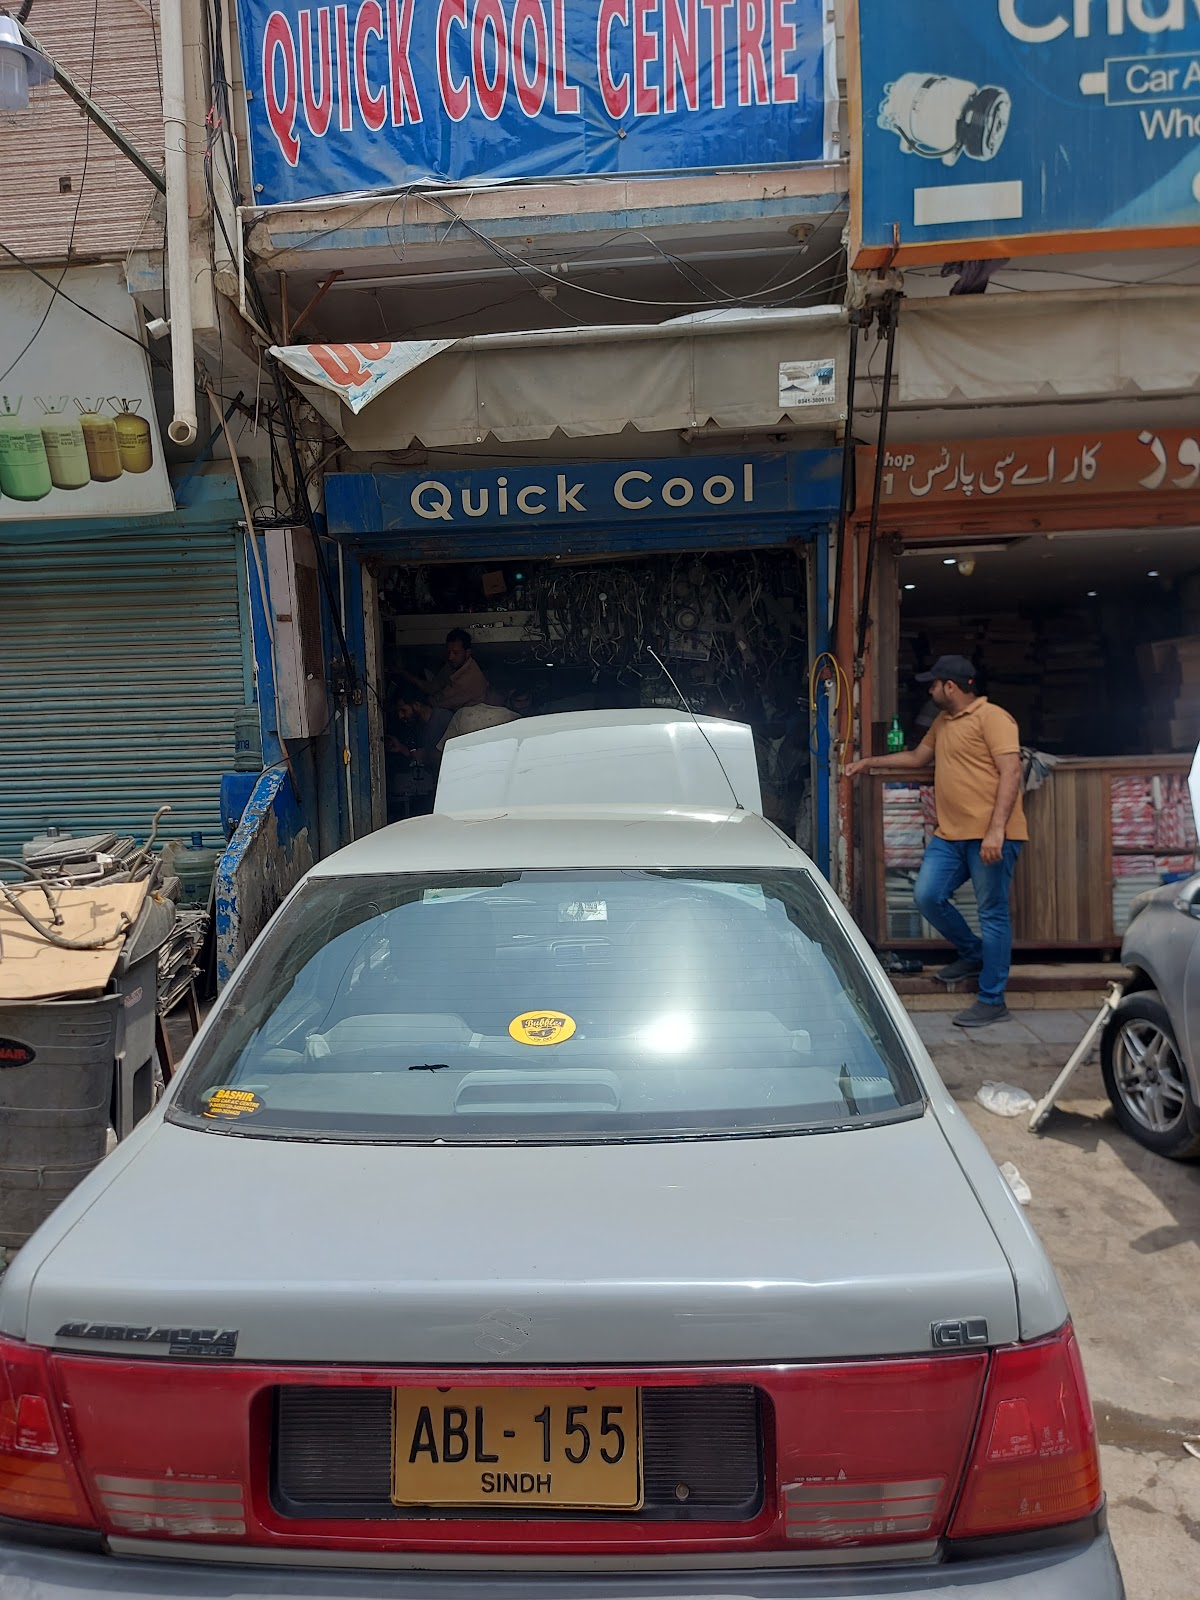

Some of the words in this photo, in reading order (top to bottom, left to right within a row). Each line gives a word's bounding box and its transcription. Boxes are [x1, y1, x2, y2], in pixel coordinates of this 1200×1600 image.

[262, 0, 424, 167] QUICK
[436, 0, 581, 122] COOL
[597, 0, 799, 120] CENTRE
[1125, 65, 1180, 94] Car
[875, 452, 915, 472] hop
[908, 445, 975, 497] پارٹس
[410, 474, 587, 521] Quick
[613, 463, 755, 509] Cool
[524, 1017, 562, 1029] Bubbles
[215, 1089, 255, 1101] BASHIR
[55, 1320, 240, 1346] MARGALLA
[932, 1318, 989, 1348] GL
[407, 1405, 625, 1464] ABL-155
[480, 1472, 553, 1495] SINDH
